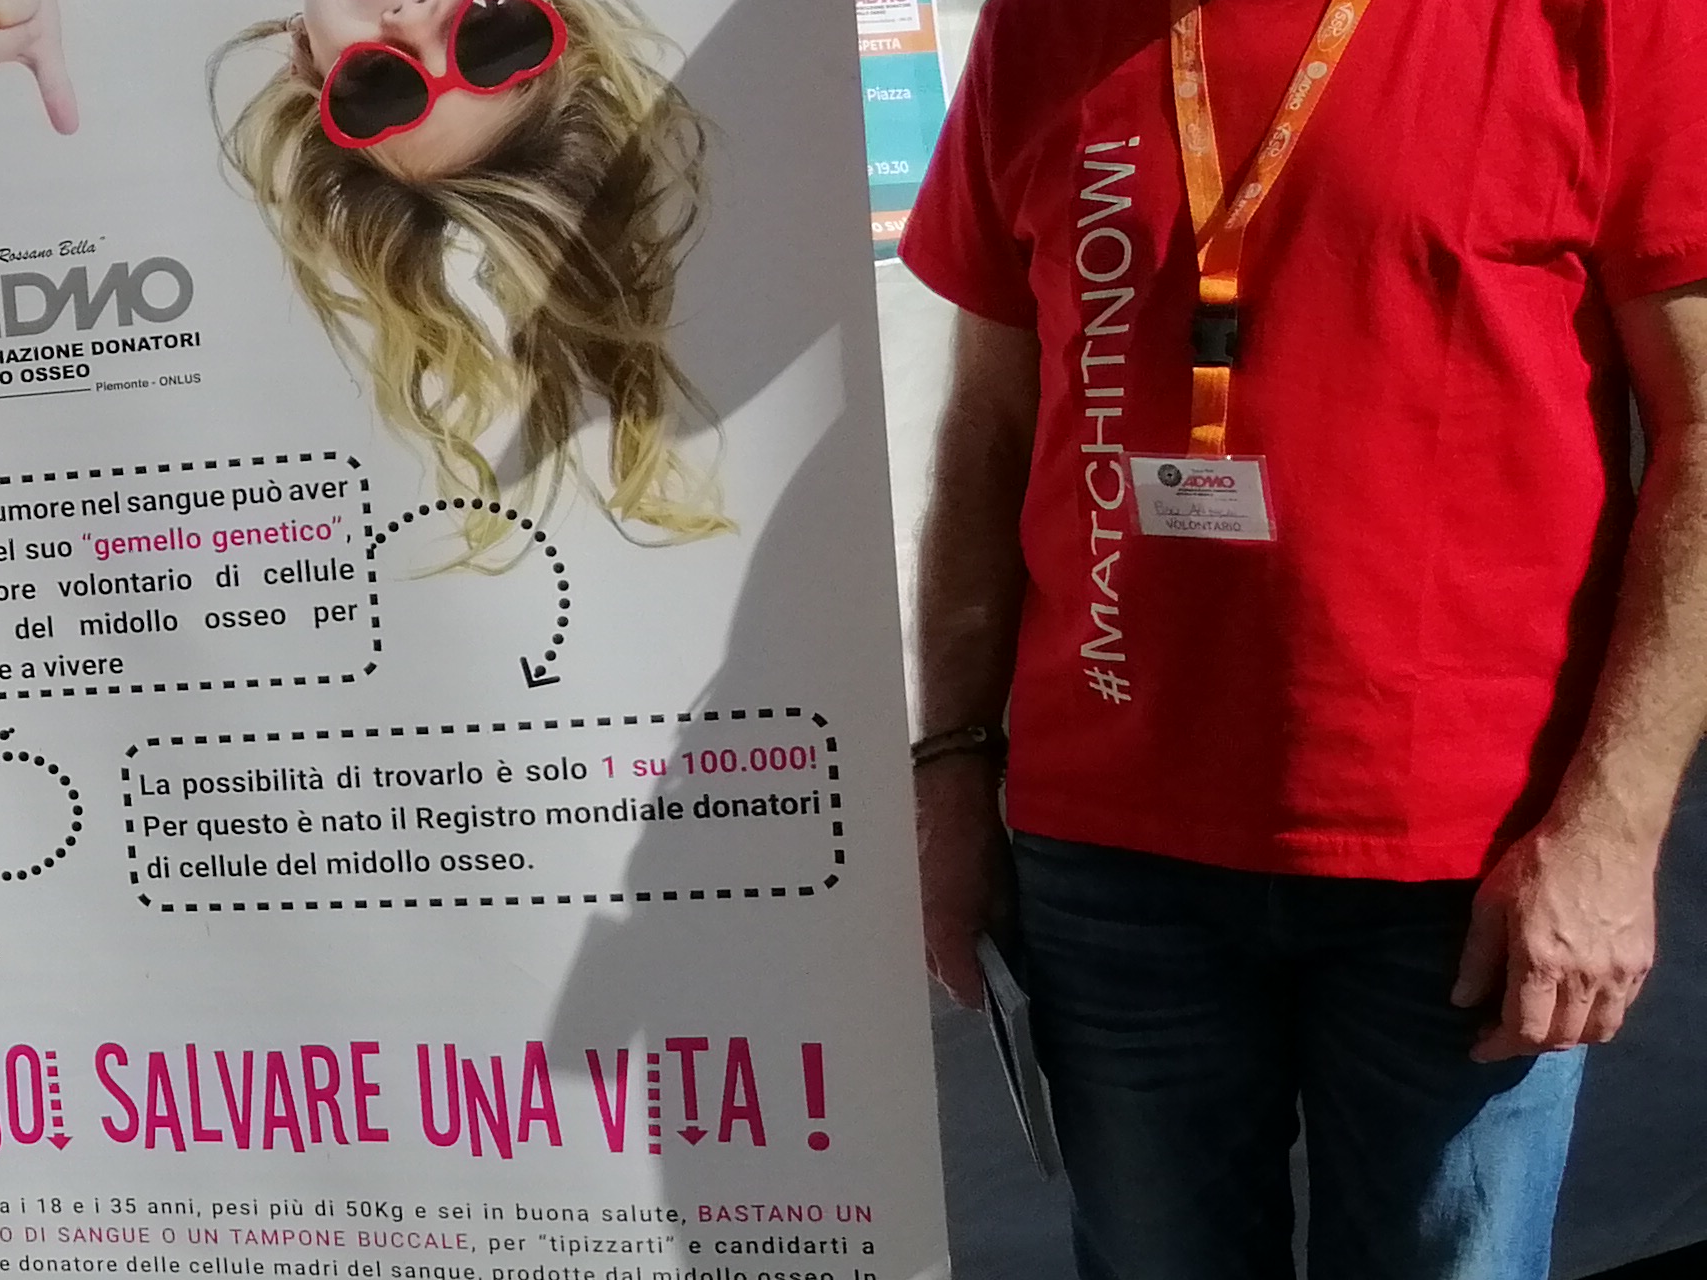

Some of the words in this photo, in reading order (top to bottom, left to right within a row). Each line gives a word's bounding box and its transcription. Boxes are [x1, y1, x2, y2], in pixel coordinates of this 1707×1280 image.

[867, 87, 912, 102] Piazza
[91, 332, 200, 355] DONATORI
[20, 363, 90, 382] OSSEO
[1077, 134, 1141, 706] #MATCHITNOW!
[81, 491, 120, 516] nel
[127, 490, 225, 515] sangue
[232, 479, 282, 511] può
[289, 480, 348, 501] aver
[1166, 520, 1242, 532] VOLONTARIO
[25, 541, 72, 560] suo
[57, 568, 192, 597] volontario
[216, 564, 239, 588] di
[264, 557, 355, 585] cellule
[15, 615, 53, 640] del
[80, 609, 178, 636] midollo
[205, 608, 286, 629] osseo
[313, 604, 358, 629] per
[21, 662, 35, 679] a
[43, 654, 123, 677] vivere
[139, 774, 171, 796] La
[183, 767, 324, 800] possibilità
[337, 765, 360, 789] di
[373, 761, 483, 788] trovarlo
[497, 759, 513, 783] è
[525, 756, 587, 782] solo
[602, 756, 614, 778] 1
[632, 757, 667, 777] su
[681, 745, 817, 776] 100.000!
[143, 816, 188, 837] Per
[197, 814, 288, 842] questo
[297, 810, 313, 833] è
[321, 810, 382, 832] nato
[391, 806, 406, 831] il
[416, 804, 536, 834] Registro
[546, 796, 684, 825] mondiale
[693, 790, 820, 819] donatori
[147, 856, 170, 879] di
[179, 853, 267, 878] cellule
[276, 852, 316, 876] del
[327, 849, 430, 875] midollo
[440, 853, 534, 872] osseo.
[93, 1039, 391, 1154] SALVARE
[415, 1039, 566, 1162] UNA
[585, 1035, 768, 1157] VITA
[800, 1041, 832, 1152] !
